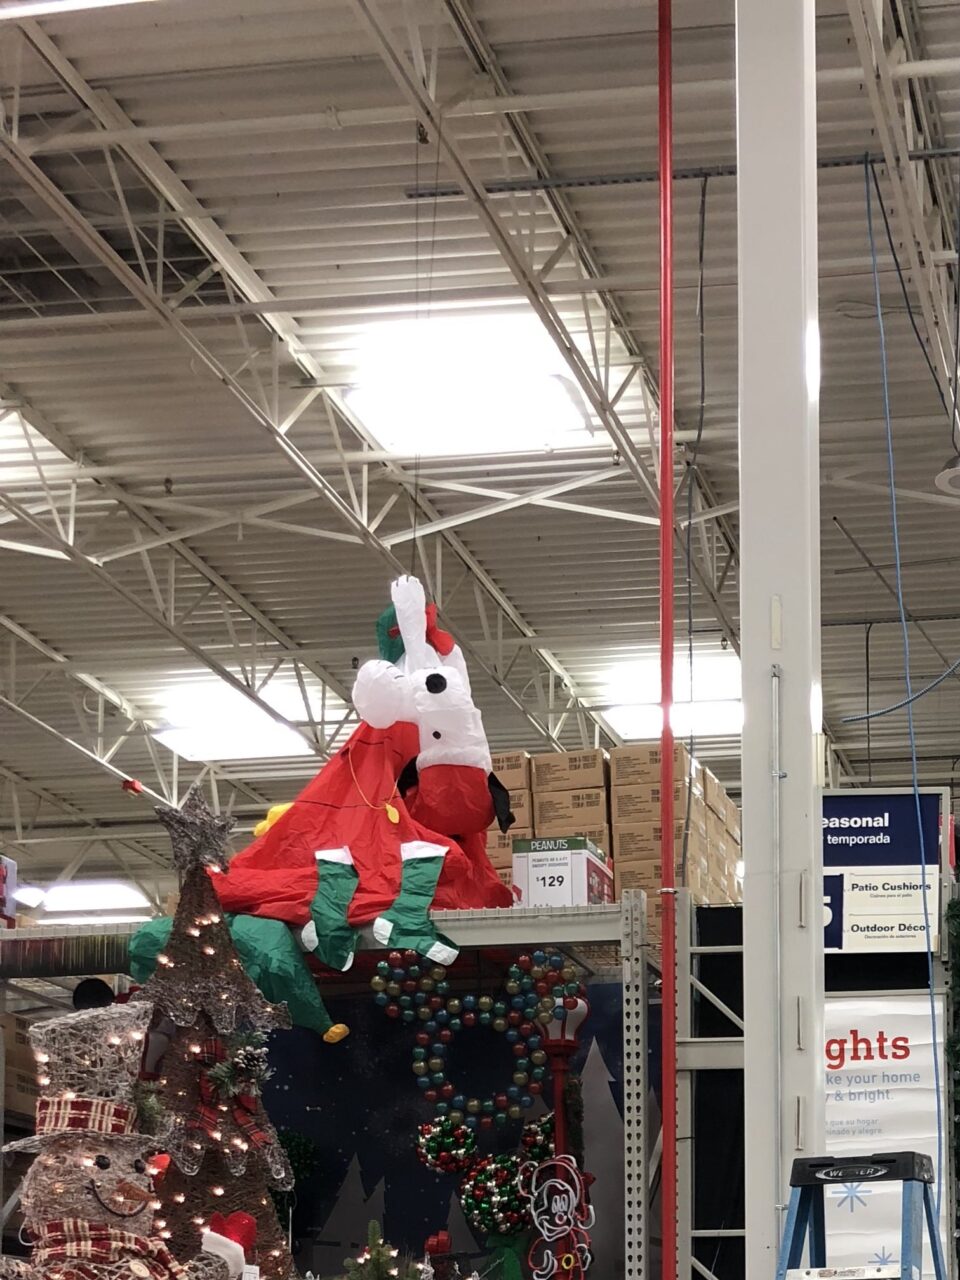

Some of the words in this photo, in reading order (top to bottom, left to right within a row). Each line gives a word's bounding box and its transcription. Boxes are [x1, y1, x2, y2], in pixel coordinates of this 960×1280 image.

[822, 813, 889, 827] easonal
[530, 839, 568, 850] PEANUTS
[827, 833, 890, 847] temporada
[851, 883, 879, 891] Patio
[851, 923, 895, 933] Outdoor
[825, 1029, 911, 1070] ghts
[826, 1074, 842, 1085] ke
[846, 1074, 878, 1087] your
[882, 1072, 921, 1083] home
[834, 1091, 844, 1102] &
